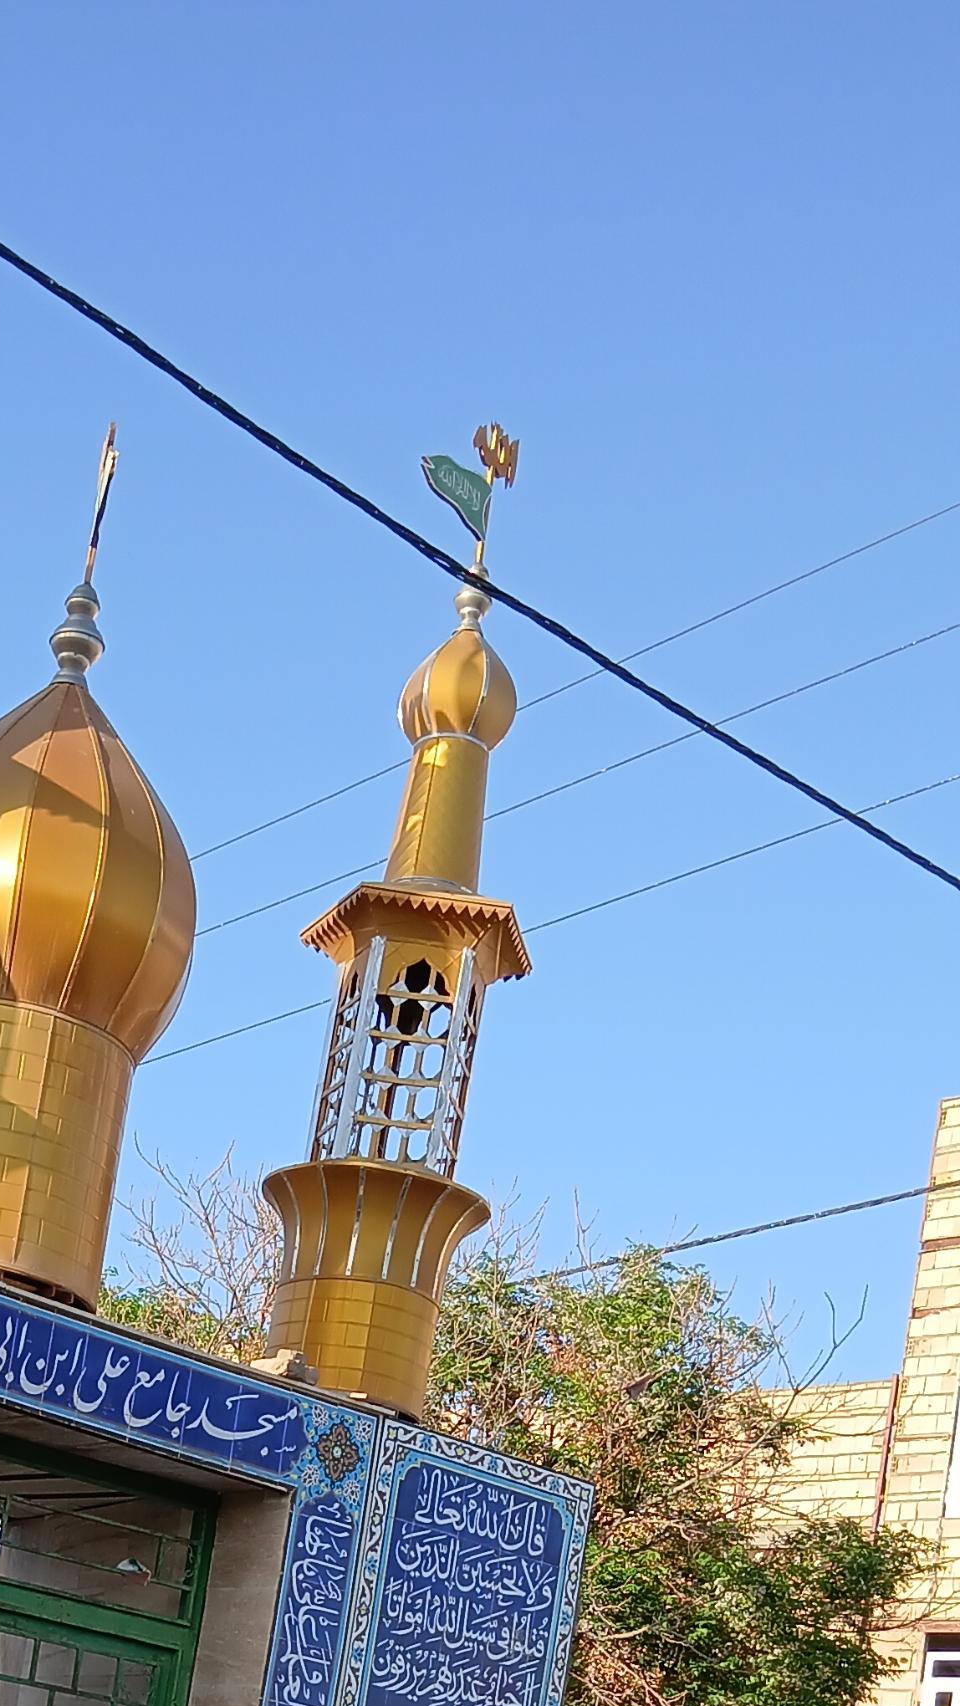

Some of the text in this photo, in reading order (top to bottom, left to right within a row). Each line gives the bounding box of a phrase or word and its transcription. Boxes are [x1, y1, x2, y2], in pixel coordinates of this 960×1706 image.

[20, 1338, 83, 1396] ابن
[73, 1347, 131, 1413] علی
[123, 1368, 191, 1438] جامع
[186, 1394, 299, 1457] مسجد
[498, 1501, 545, 1556] قال
